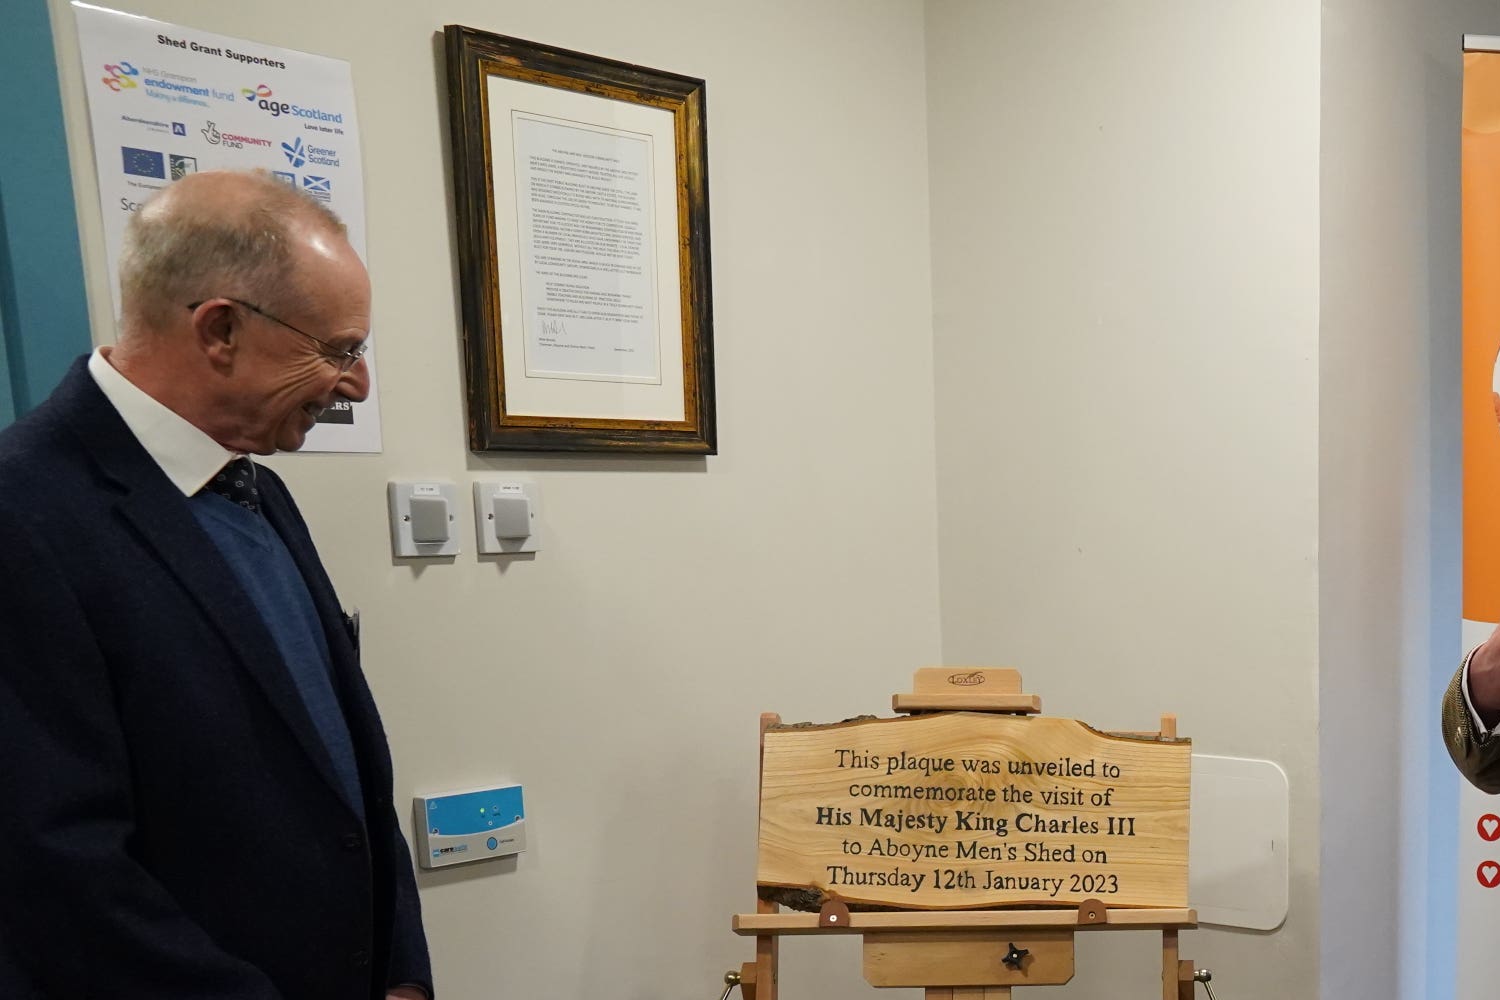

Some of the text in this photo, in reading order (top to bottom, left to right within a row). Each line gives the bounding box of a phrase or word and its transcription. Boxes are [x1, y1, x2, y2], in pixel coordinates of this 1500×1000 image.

[157, 34, 286, 70] Shed Grant Supporters
[144, 78, 235, 102] endowment fund
[221, 133, 272, 148] COMMUNITY
[222, 140, 244, 150] FUND
[307, 144, 336, 157] Greener
[308, 154, 340, 167] Scotland
[834, 749, 1120, 779] This plaque was unveiled to
[849, 783, 1115, 807] commemorate the visit of
[815, 806, 1136, 838] His Majesty King Charles III
[841, 838, 1108, 864] to Aboyne Men's Shed on
[826, 865, 1119, 897] Thursday 12th January 2023
